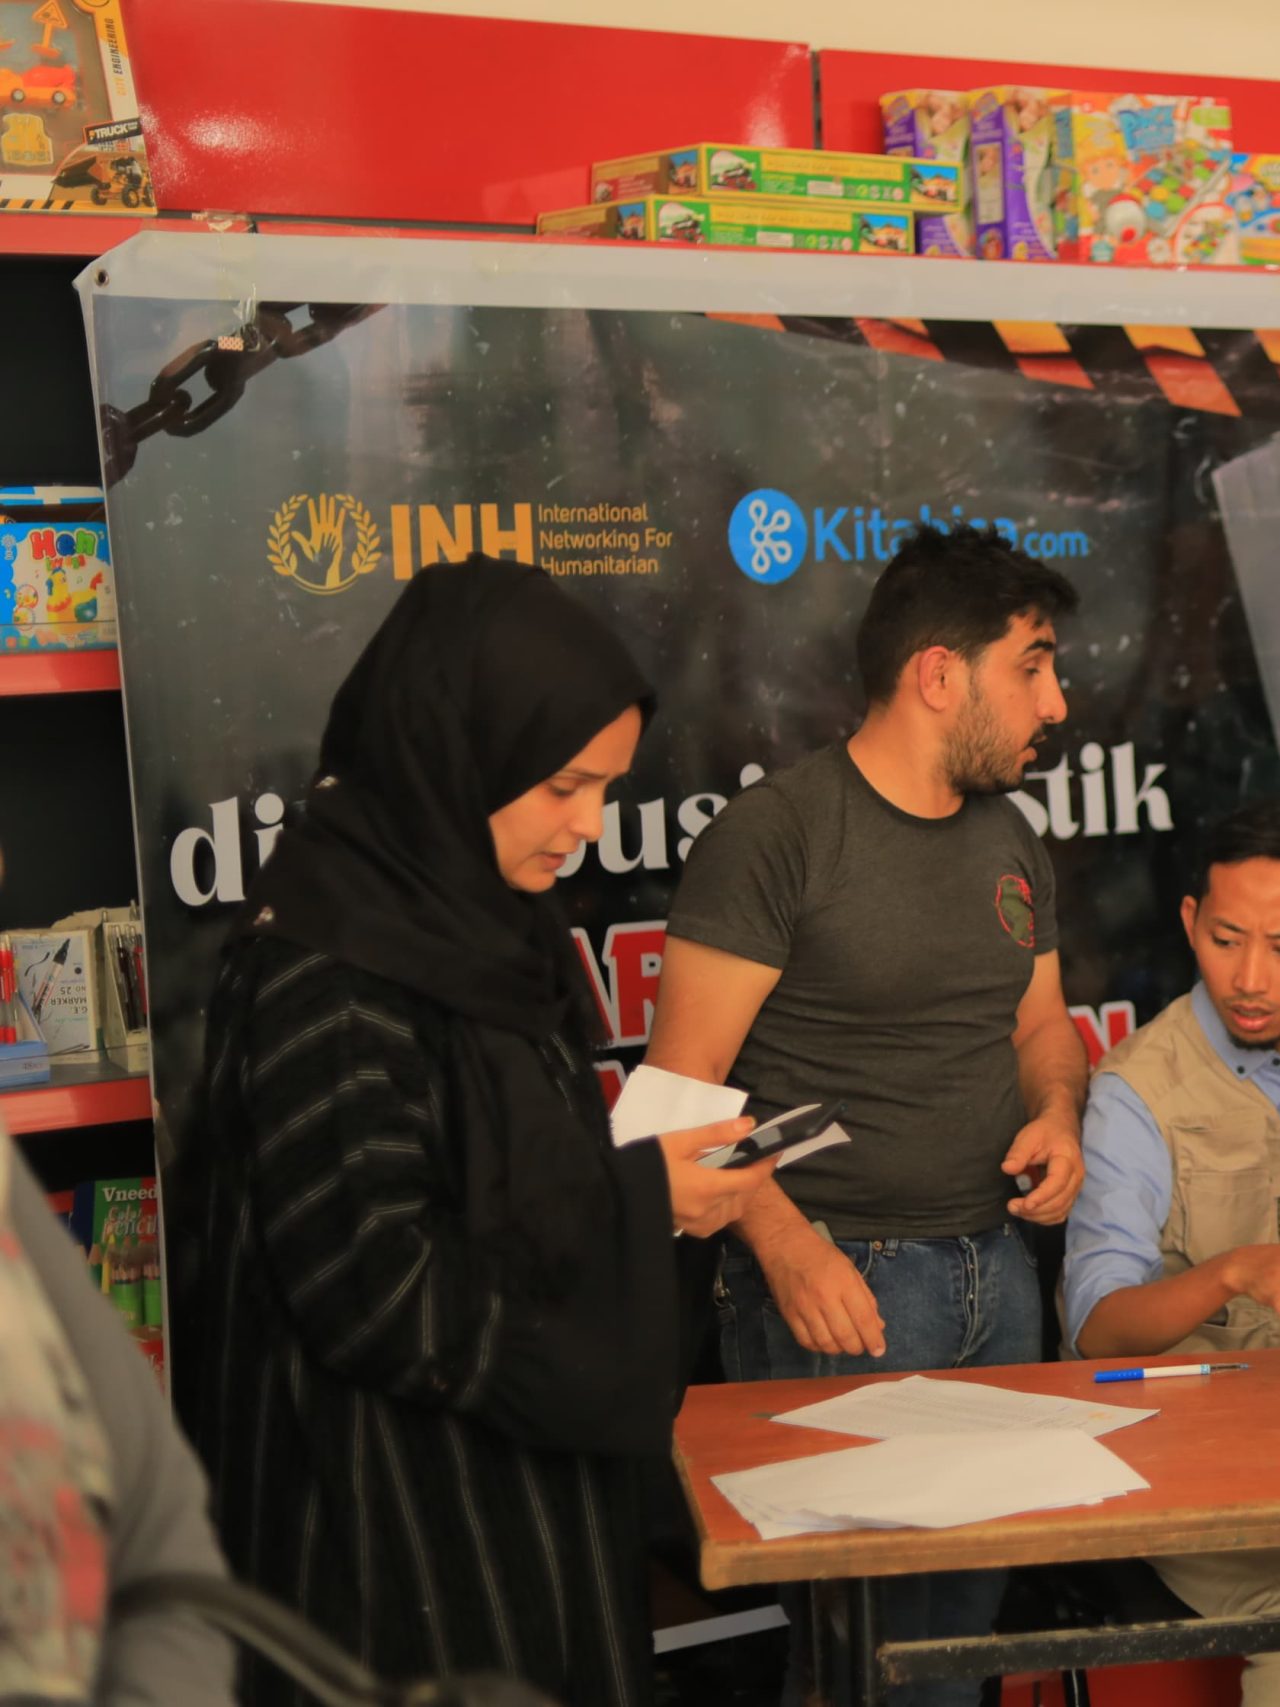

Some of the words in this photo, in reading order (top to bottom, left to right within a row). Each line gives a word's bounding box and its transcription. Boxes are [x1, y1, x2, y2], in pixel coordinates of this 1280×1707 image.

[94, 123, 129, 139] TRUCK
[538, 502, 648, 523] International
[391, 502, 534, 580] INH
[539, 530, 640, 552] Networking
[645, 528, 673, 549] For
[541, 556, 659, 577] Humanitarian
[50, 997, 87, 1006] MARKER
